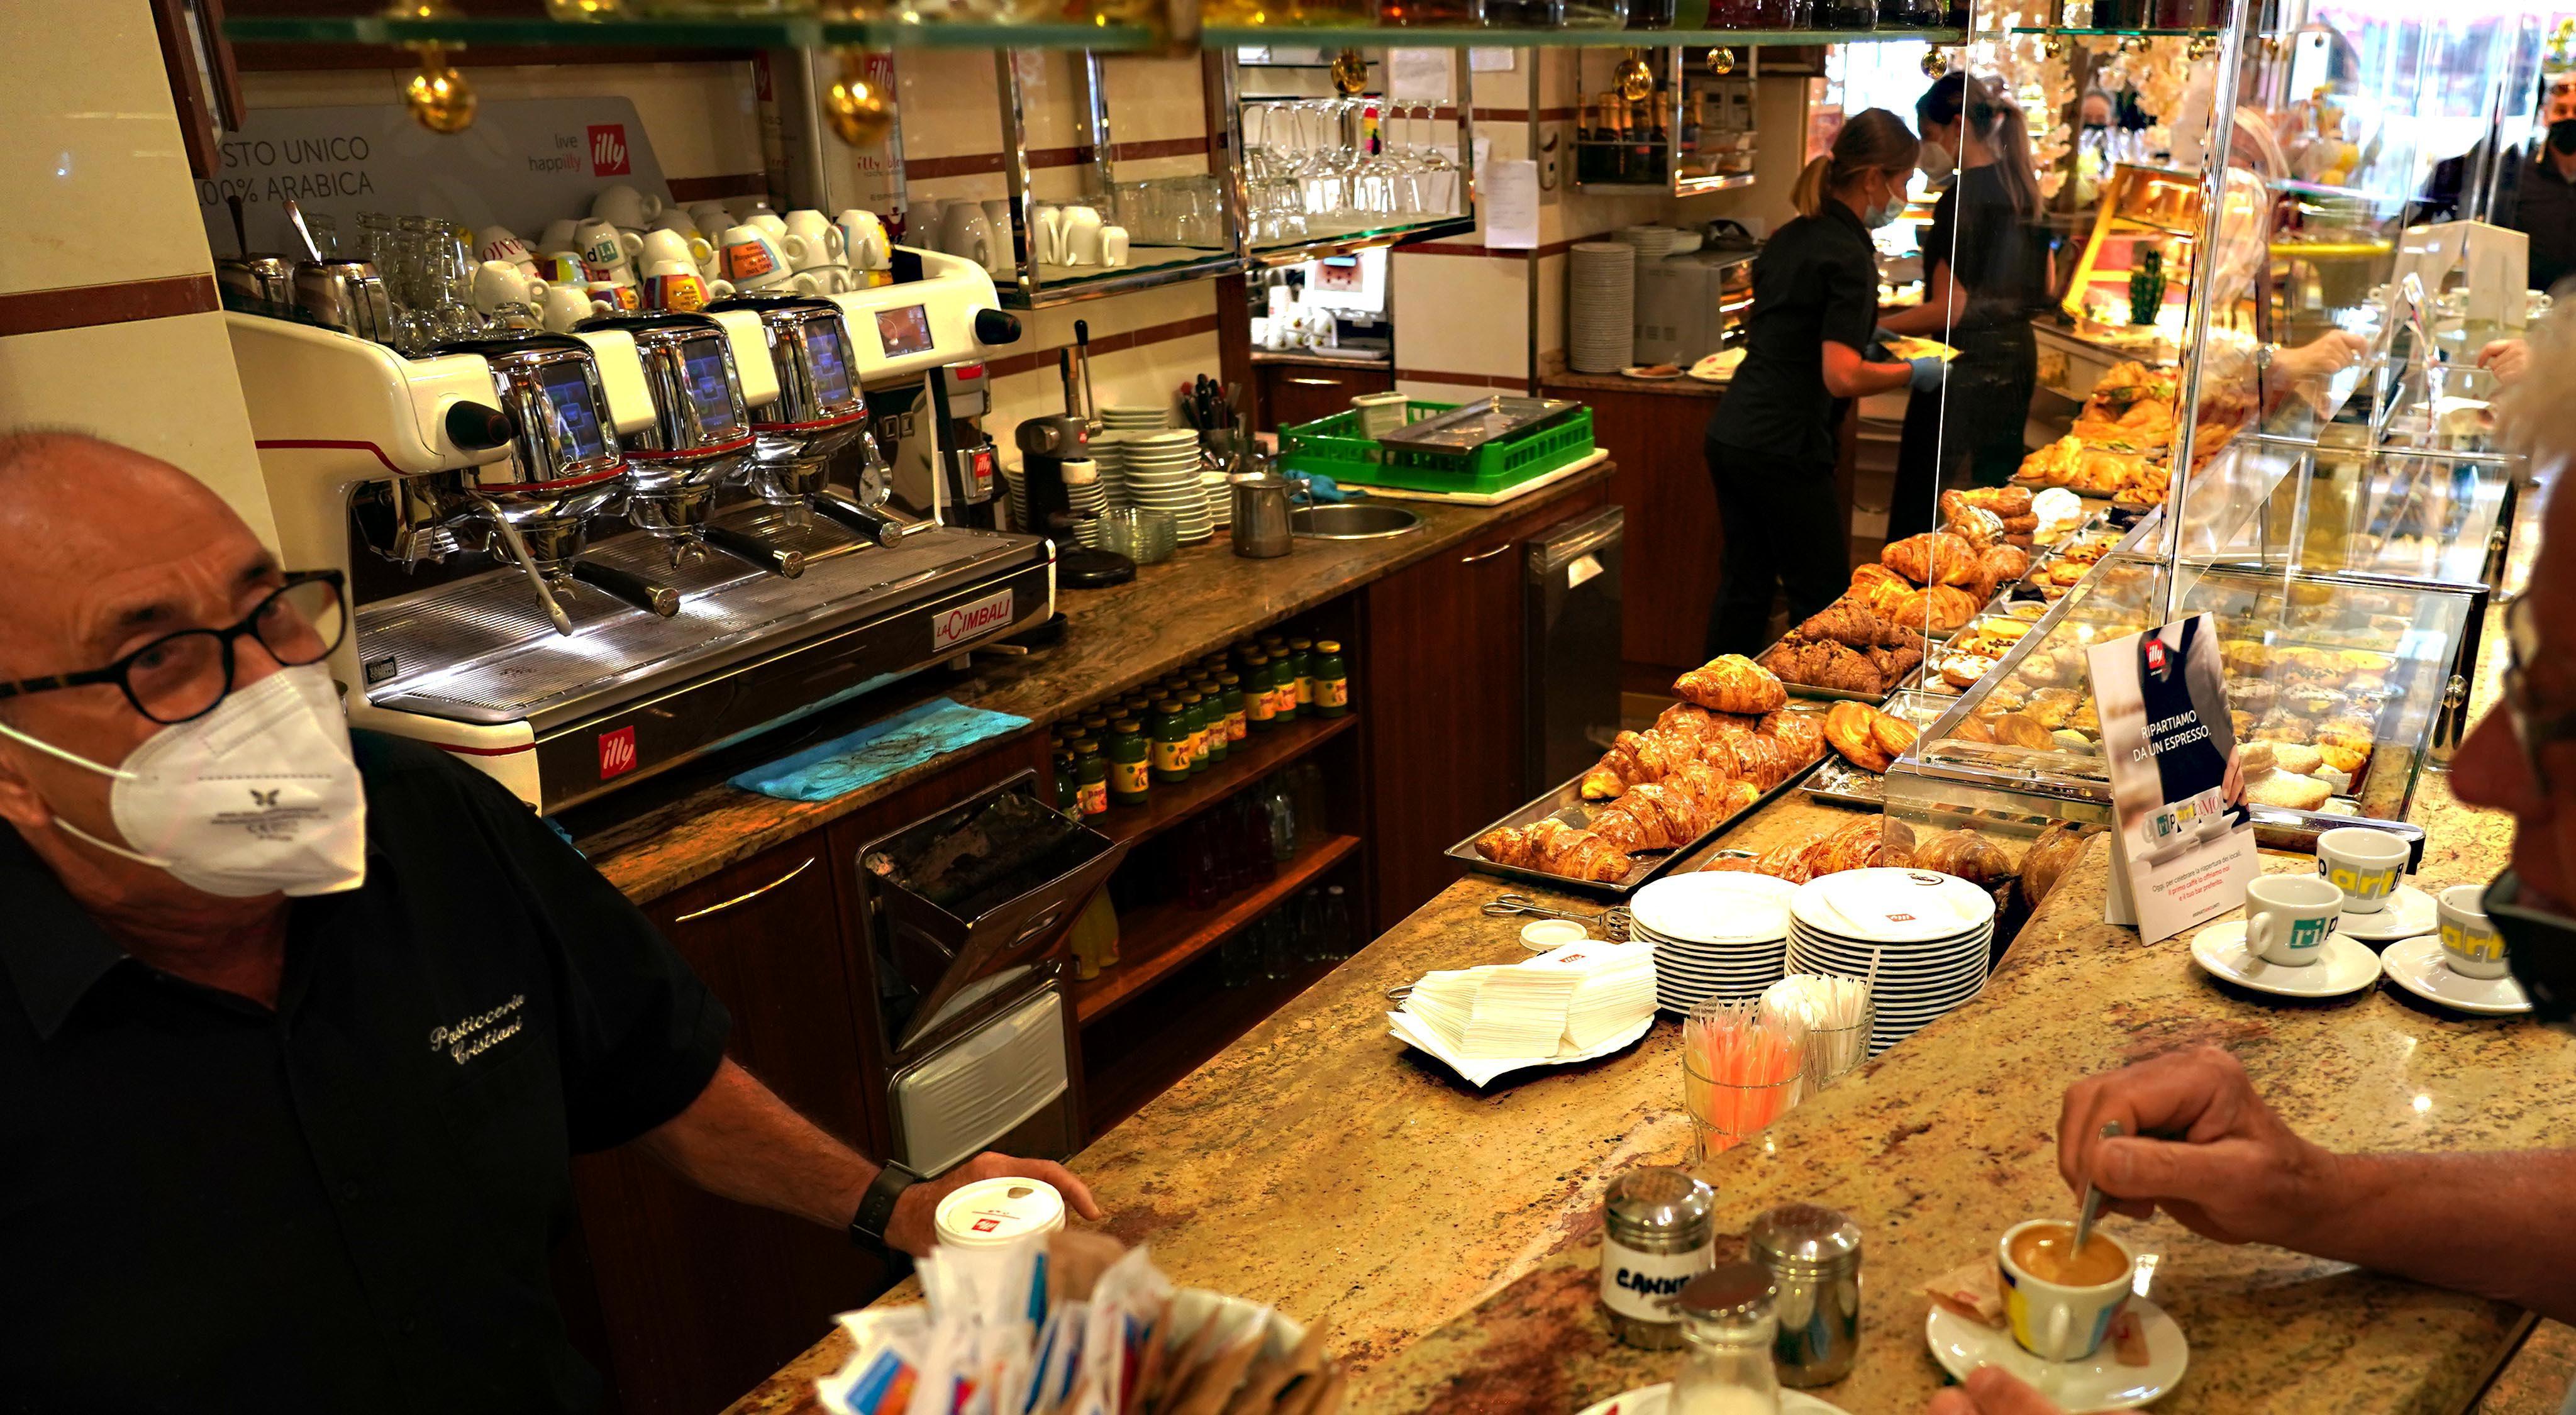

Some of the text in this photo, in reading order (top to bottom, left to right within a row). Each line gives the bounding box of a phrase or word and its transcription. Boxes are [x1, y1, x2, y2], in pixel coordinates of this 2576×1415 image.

[221, 136, 369, 167] STO UNICO
[555, 134, 578, 148] live
[595, 132, 625, 170] illy
[528, 153, 581, 172] happilly
[199, 171, 374, 206] 00% ARABICA
[977, 456, 991, 472] illy
[948, 599, 1010, 640] CIMBALI
[2149, 645, 2162, 664] illy
[2141, 710, 2197, 740] RIPARTIAMO
[603, 736, 634, 770] illy
[2133, 725, 2212, 762] DA UN ESPRESSO.
[430, 994, 525, 1052] Pasticceria
[450, 1015, 523, 1062] Cristiani
